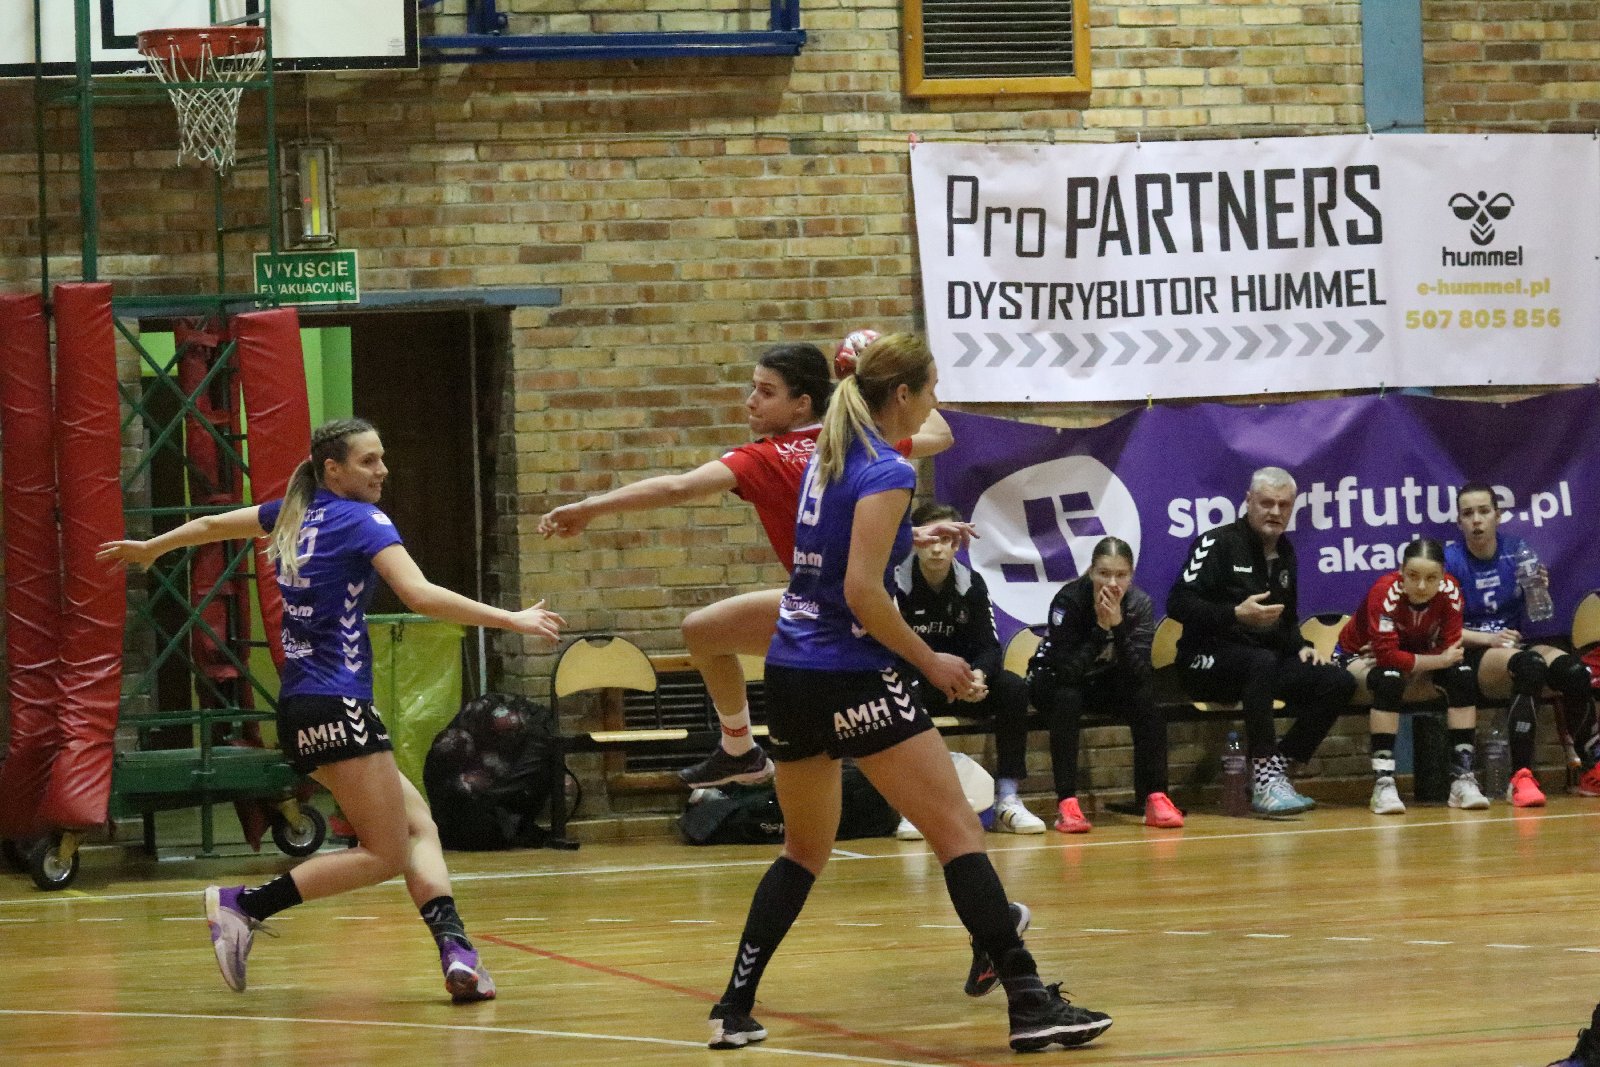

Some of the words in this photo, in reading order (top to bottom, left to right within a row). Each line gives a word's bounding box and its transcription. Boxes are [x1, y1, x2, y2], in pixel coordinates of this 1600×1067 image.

[946, 174, 1047, 259] Pro
[1064, 164, 1384, 259] PARTNERS
[263, 258, 349, 279] WYJŚCIE
[1441, 245, 1524, 267] hummel
[947, 275, 1220, 321] DYSTRYBUTOR
[1230, 267, 1388, 313] HUMMEL
[1416, 277, 1551, 298] e-hummel.pl
[1405, 309, 1454, 330] 507
[1458, 308, 1508, 329] 805
[1512, 307, 1562, 329] 856
[1166, 475, 1573, 539] sprtfutue.pl
[833, 697, 892, 732] AMH
[858, 716, 894, 736] SPORT
[297, 720, 348, 749] AMH
